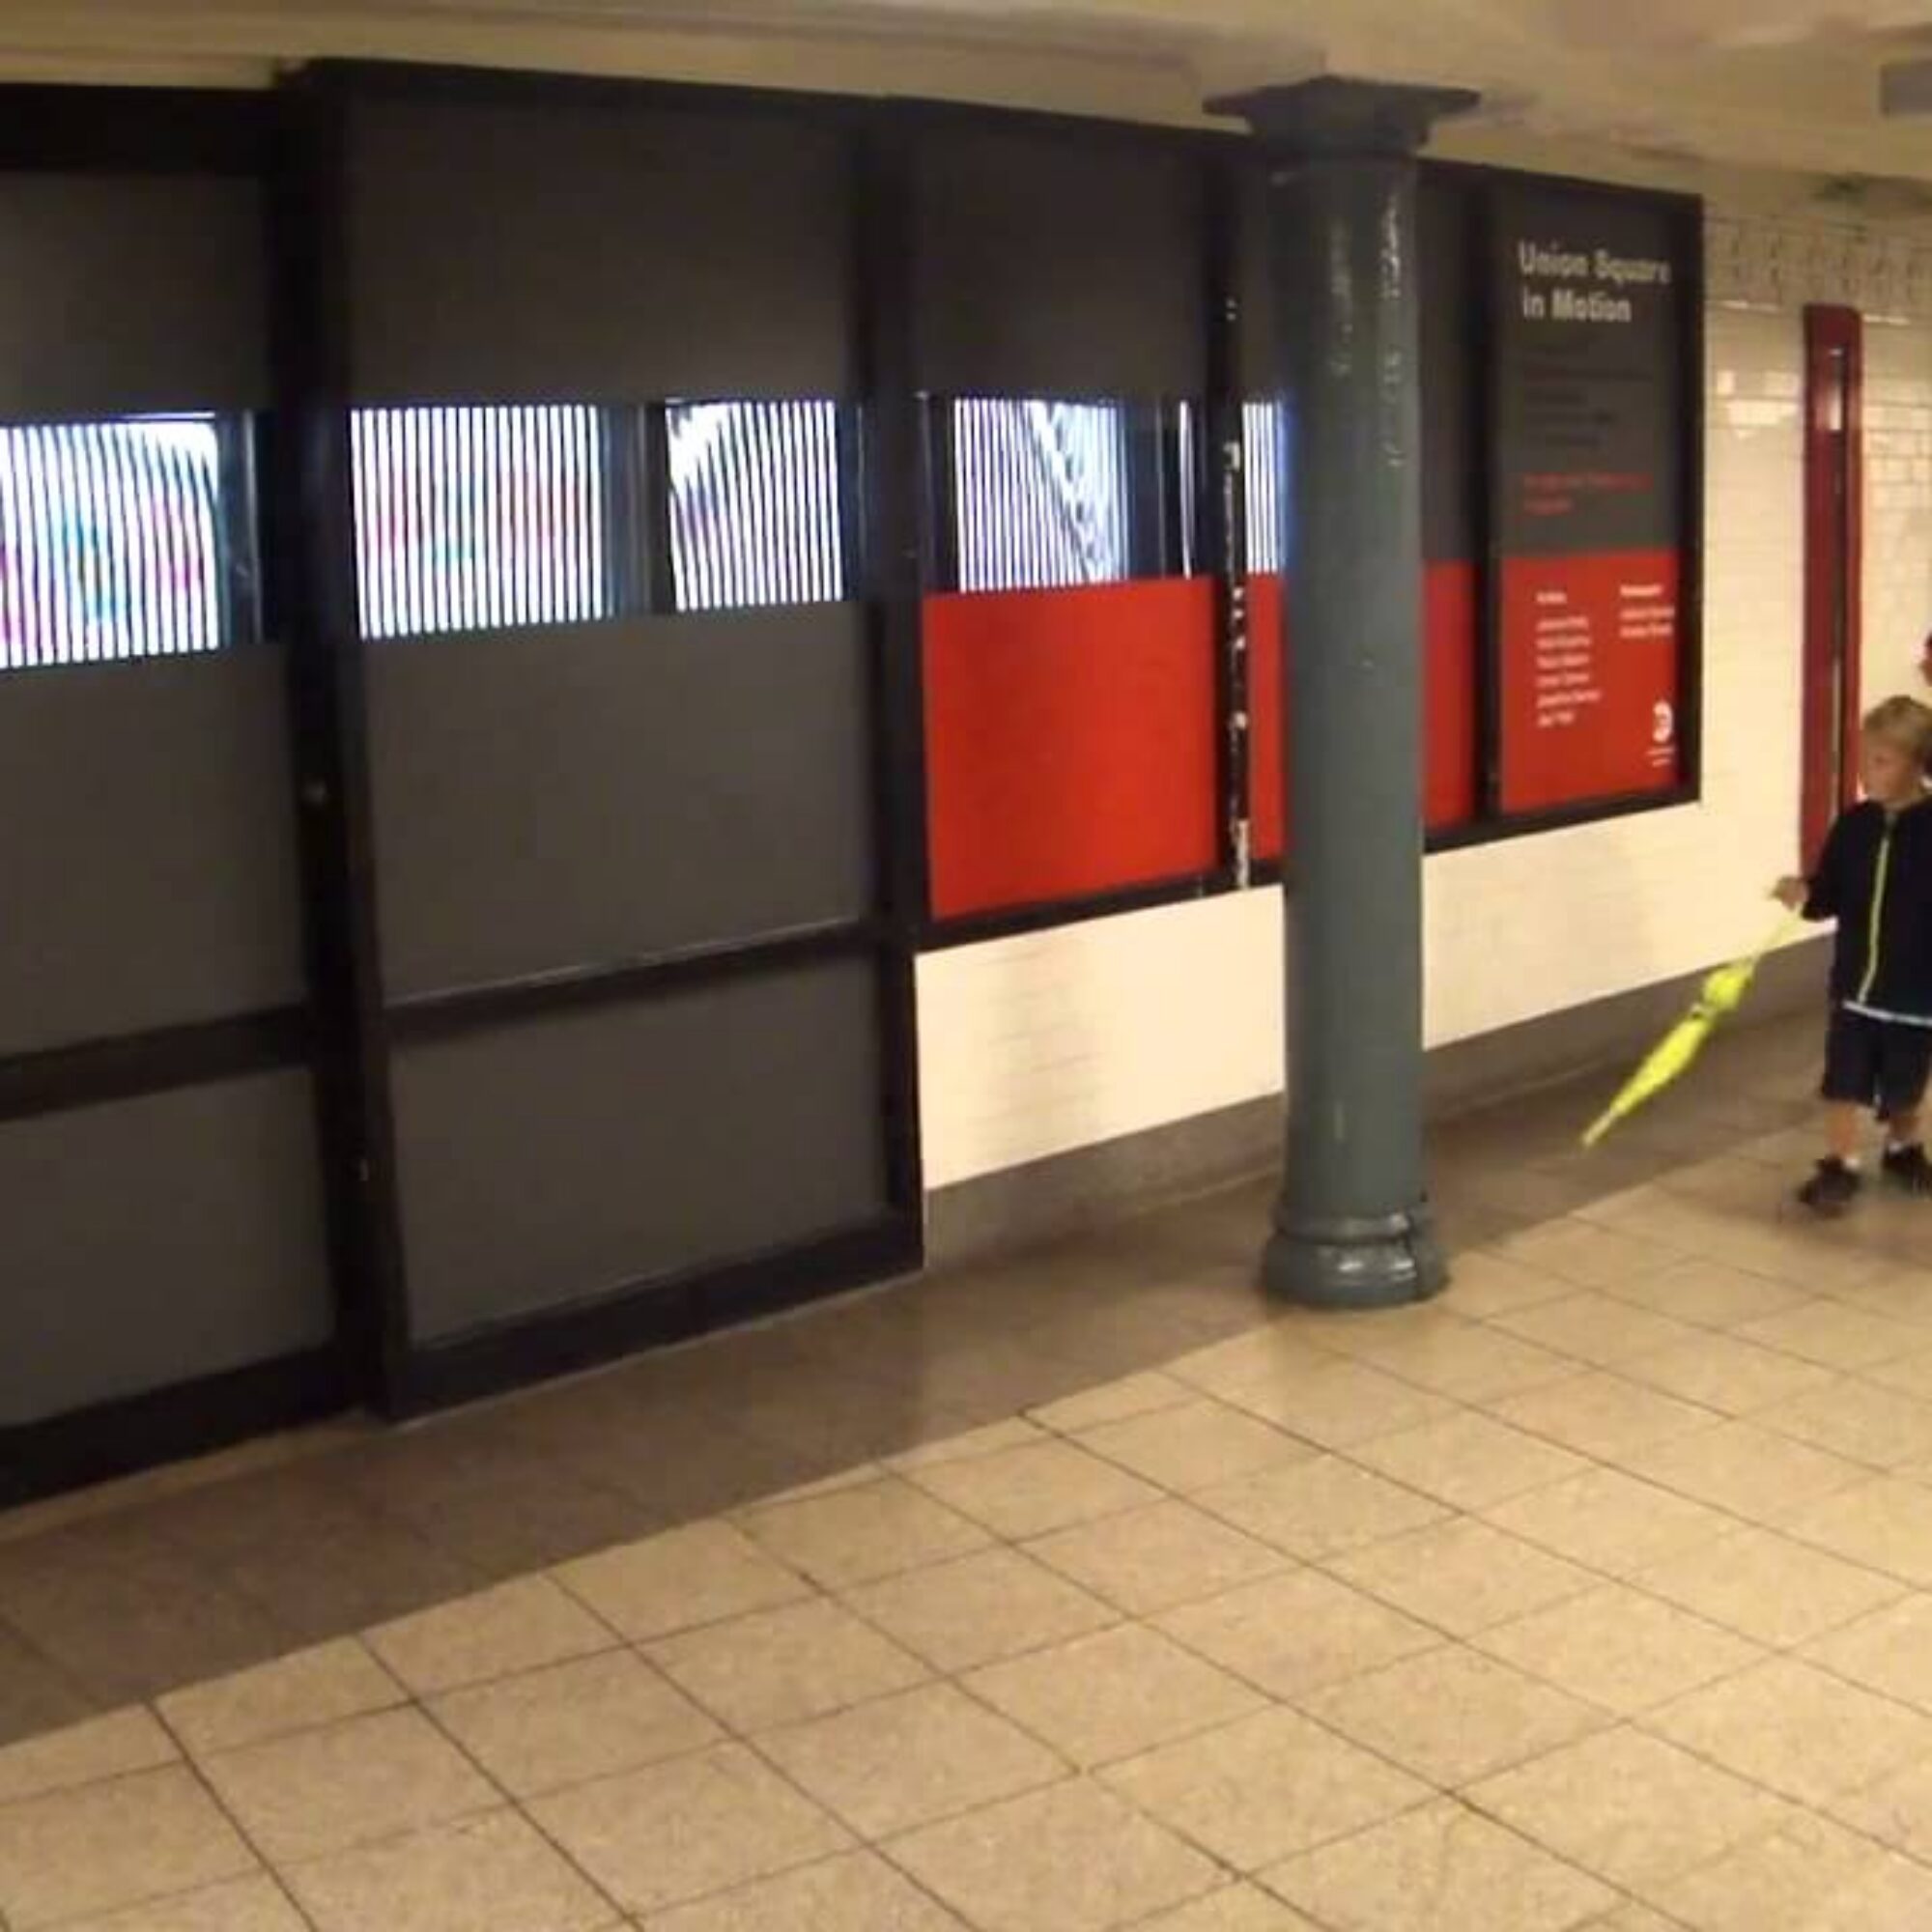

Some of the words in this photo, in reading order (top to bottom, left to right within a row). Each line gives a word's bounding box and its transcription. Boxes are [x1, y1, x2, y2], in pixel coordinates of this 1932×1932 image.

[1519, 241, 1588, 276] Union
[1596, 248, 1672, 287] Square
[1551, 289, 1632, 323] Motion
